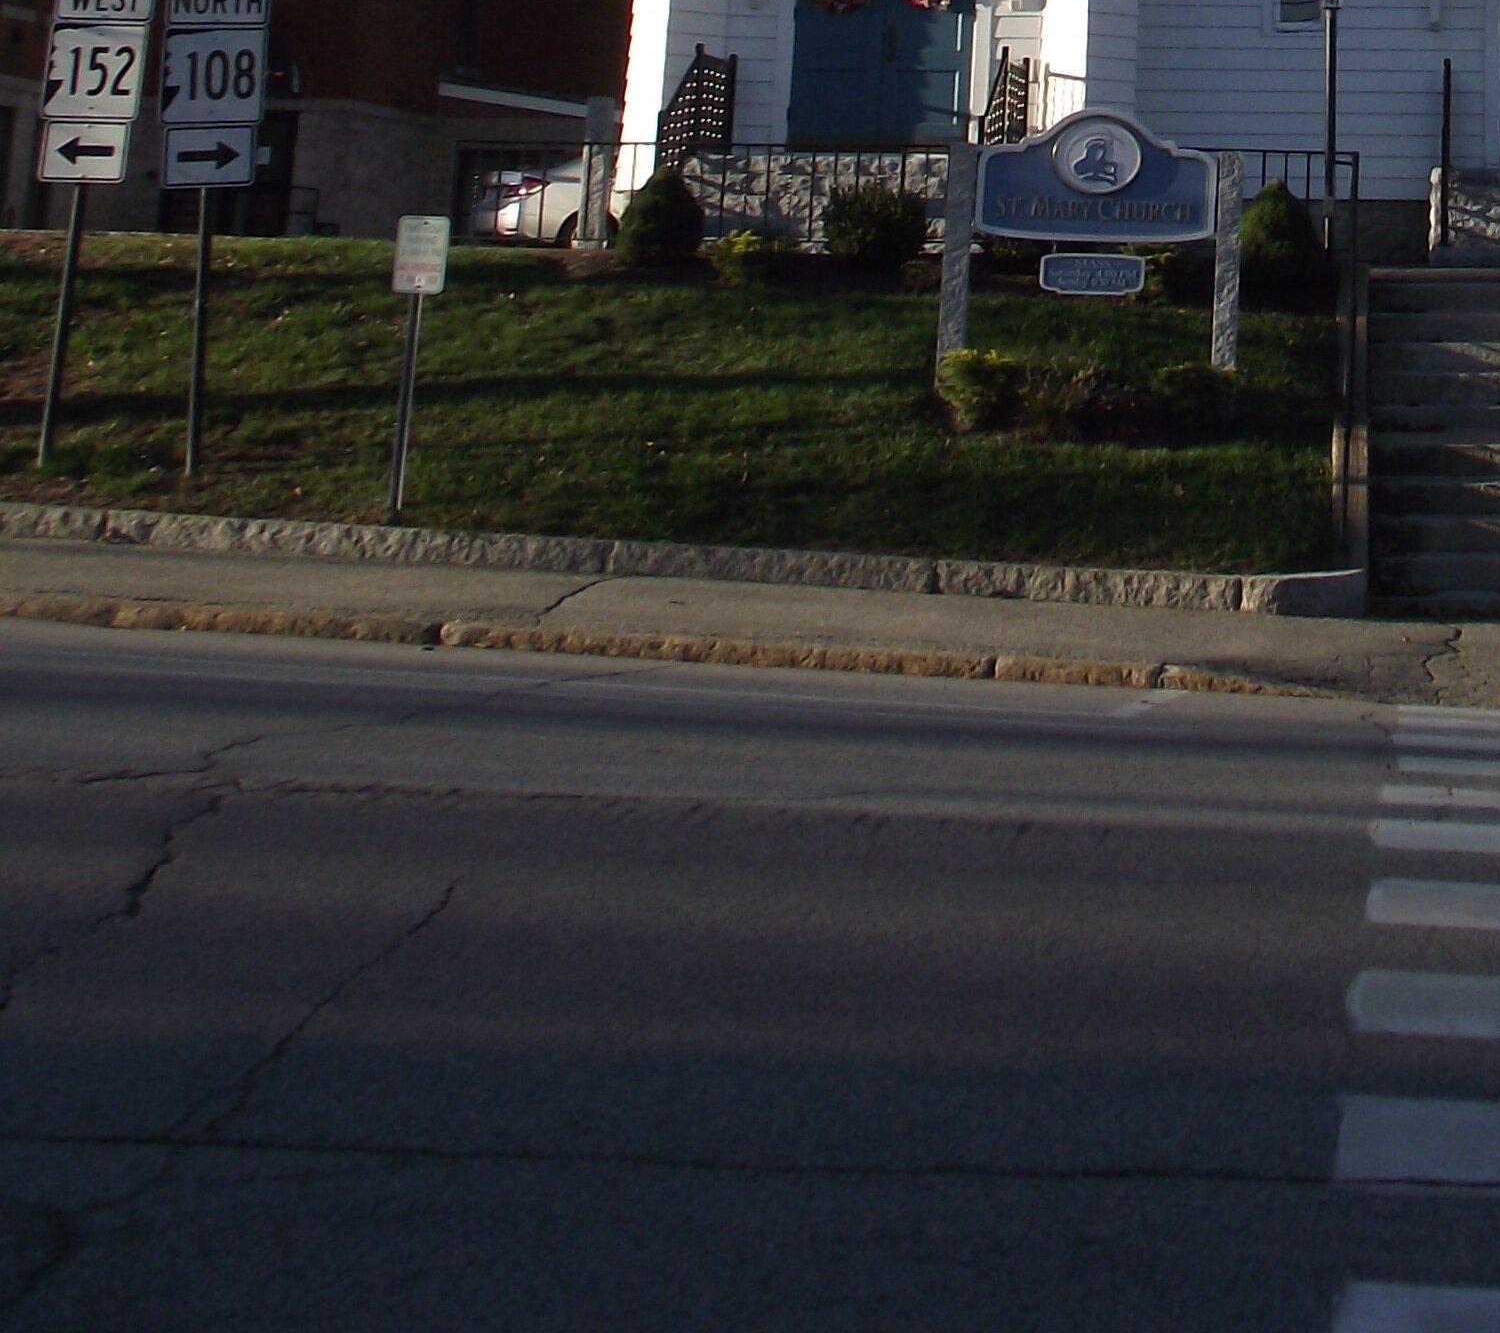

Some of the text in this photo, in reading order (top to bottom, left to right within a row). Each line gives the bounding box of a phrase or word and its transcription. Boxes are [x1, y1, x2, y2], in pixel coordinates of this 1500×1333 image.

[68, 45, 137, 97] 152
[186, 48, 256, 101] 108
[1030, 196, 1092, 220] MARY
[1097, 197, 1191, 222] CHURCH
